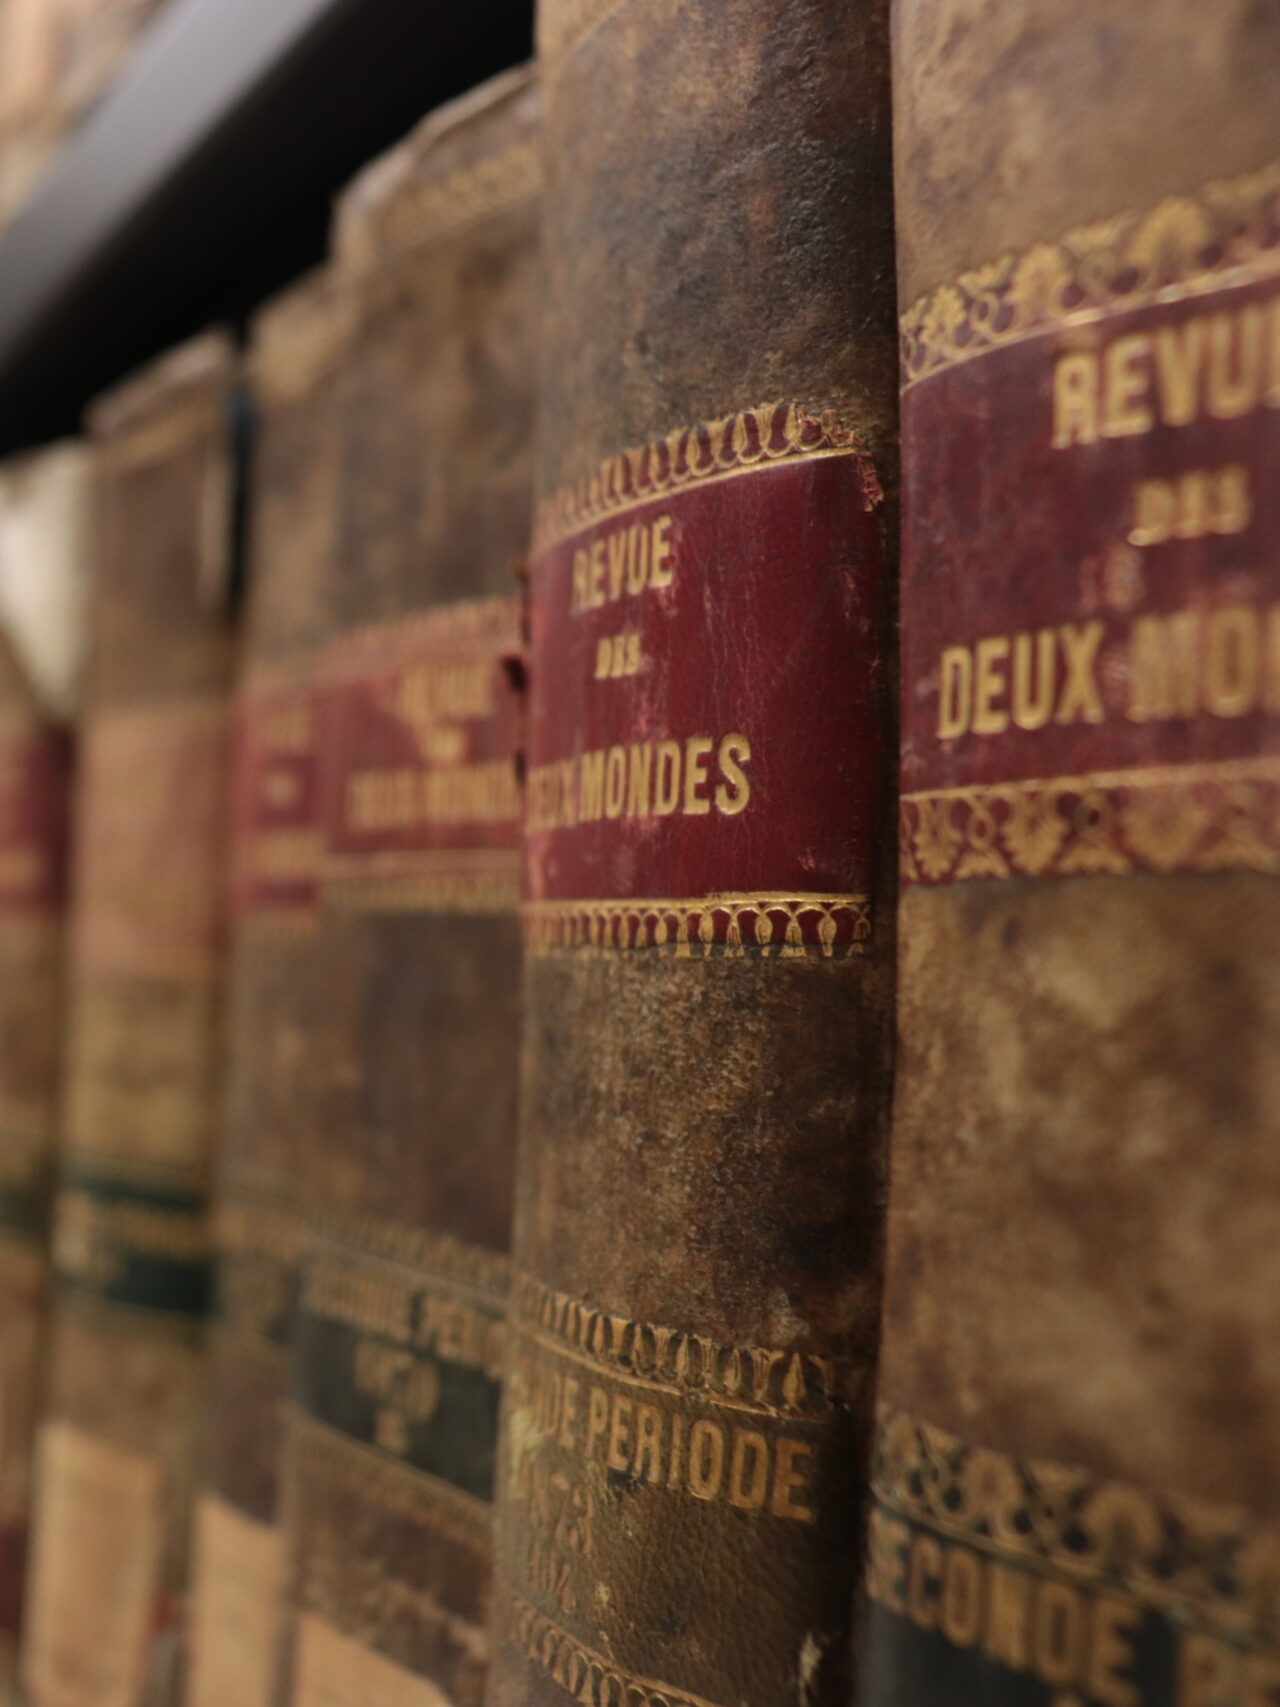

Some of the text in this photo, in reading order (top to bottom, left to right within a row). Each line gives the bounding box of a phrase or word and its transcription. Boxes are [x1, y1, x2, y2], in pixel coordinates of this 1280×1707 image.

[1051, 298, 1280, 449] REVU
[571, 515, 673, 614] REVUE
[936, 605, 1280, 739] DEUX MO
[578, 733, 751, 822] MONDES
[584, 1385, 816, 1525] PERIODE
